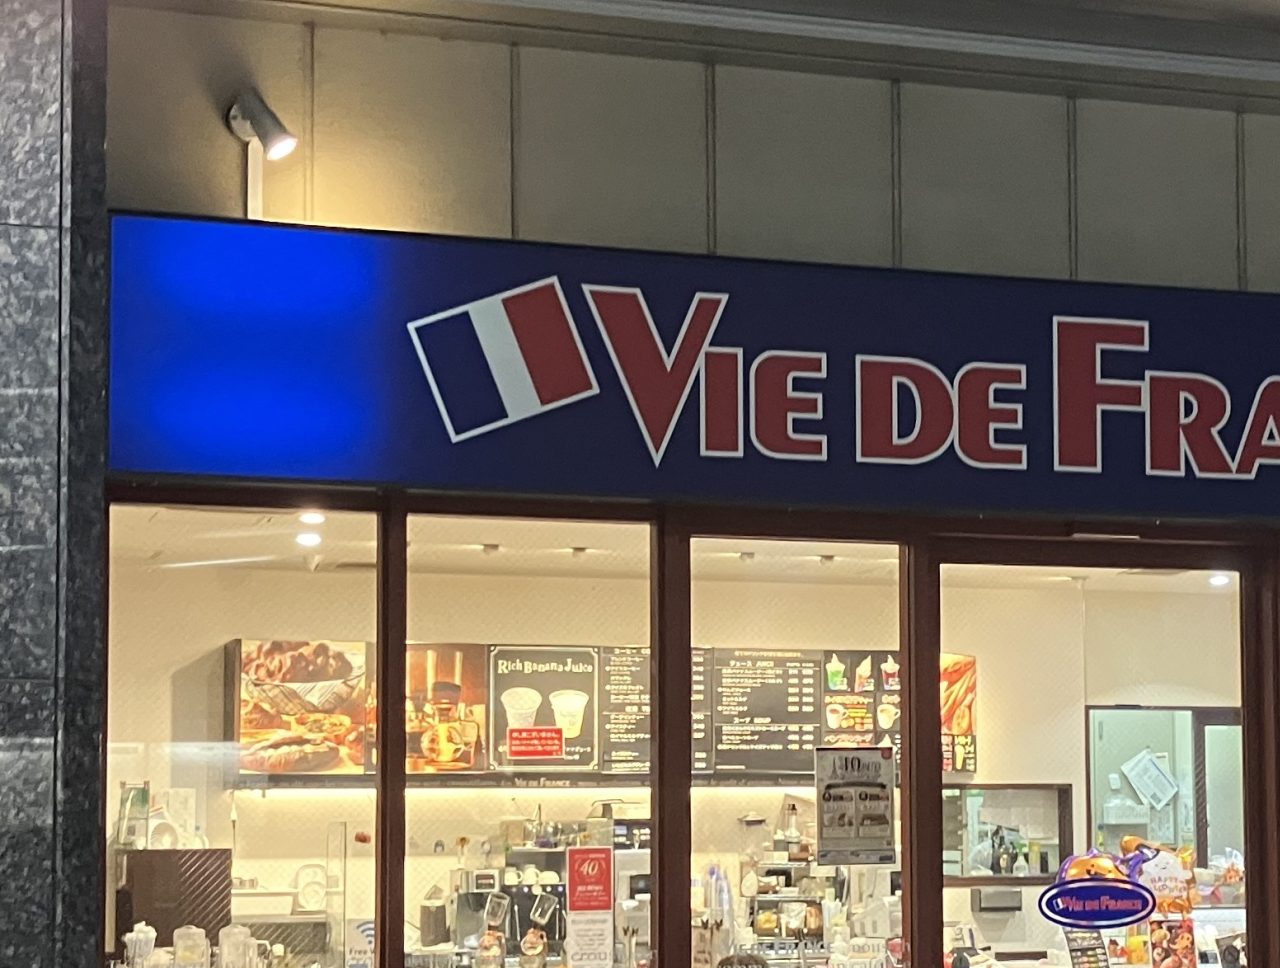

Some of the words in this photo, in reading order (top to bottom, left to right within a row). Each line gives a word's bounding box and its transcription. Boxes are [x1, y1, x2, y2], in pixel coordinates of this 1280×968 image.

[581, 283, 827, 468] VIE
[855, 353, 1027, 469] DE
[498, 659, 522, 674] Rich
